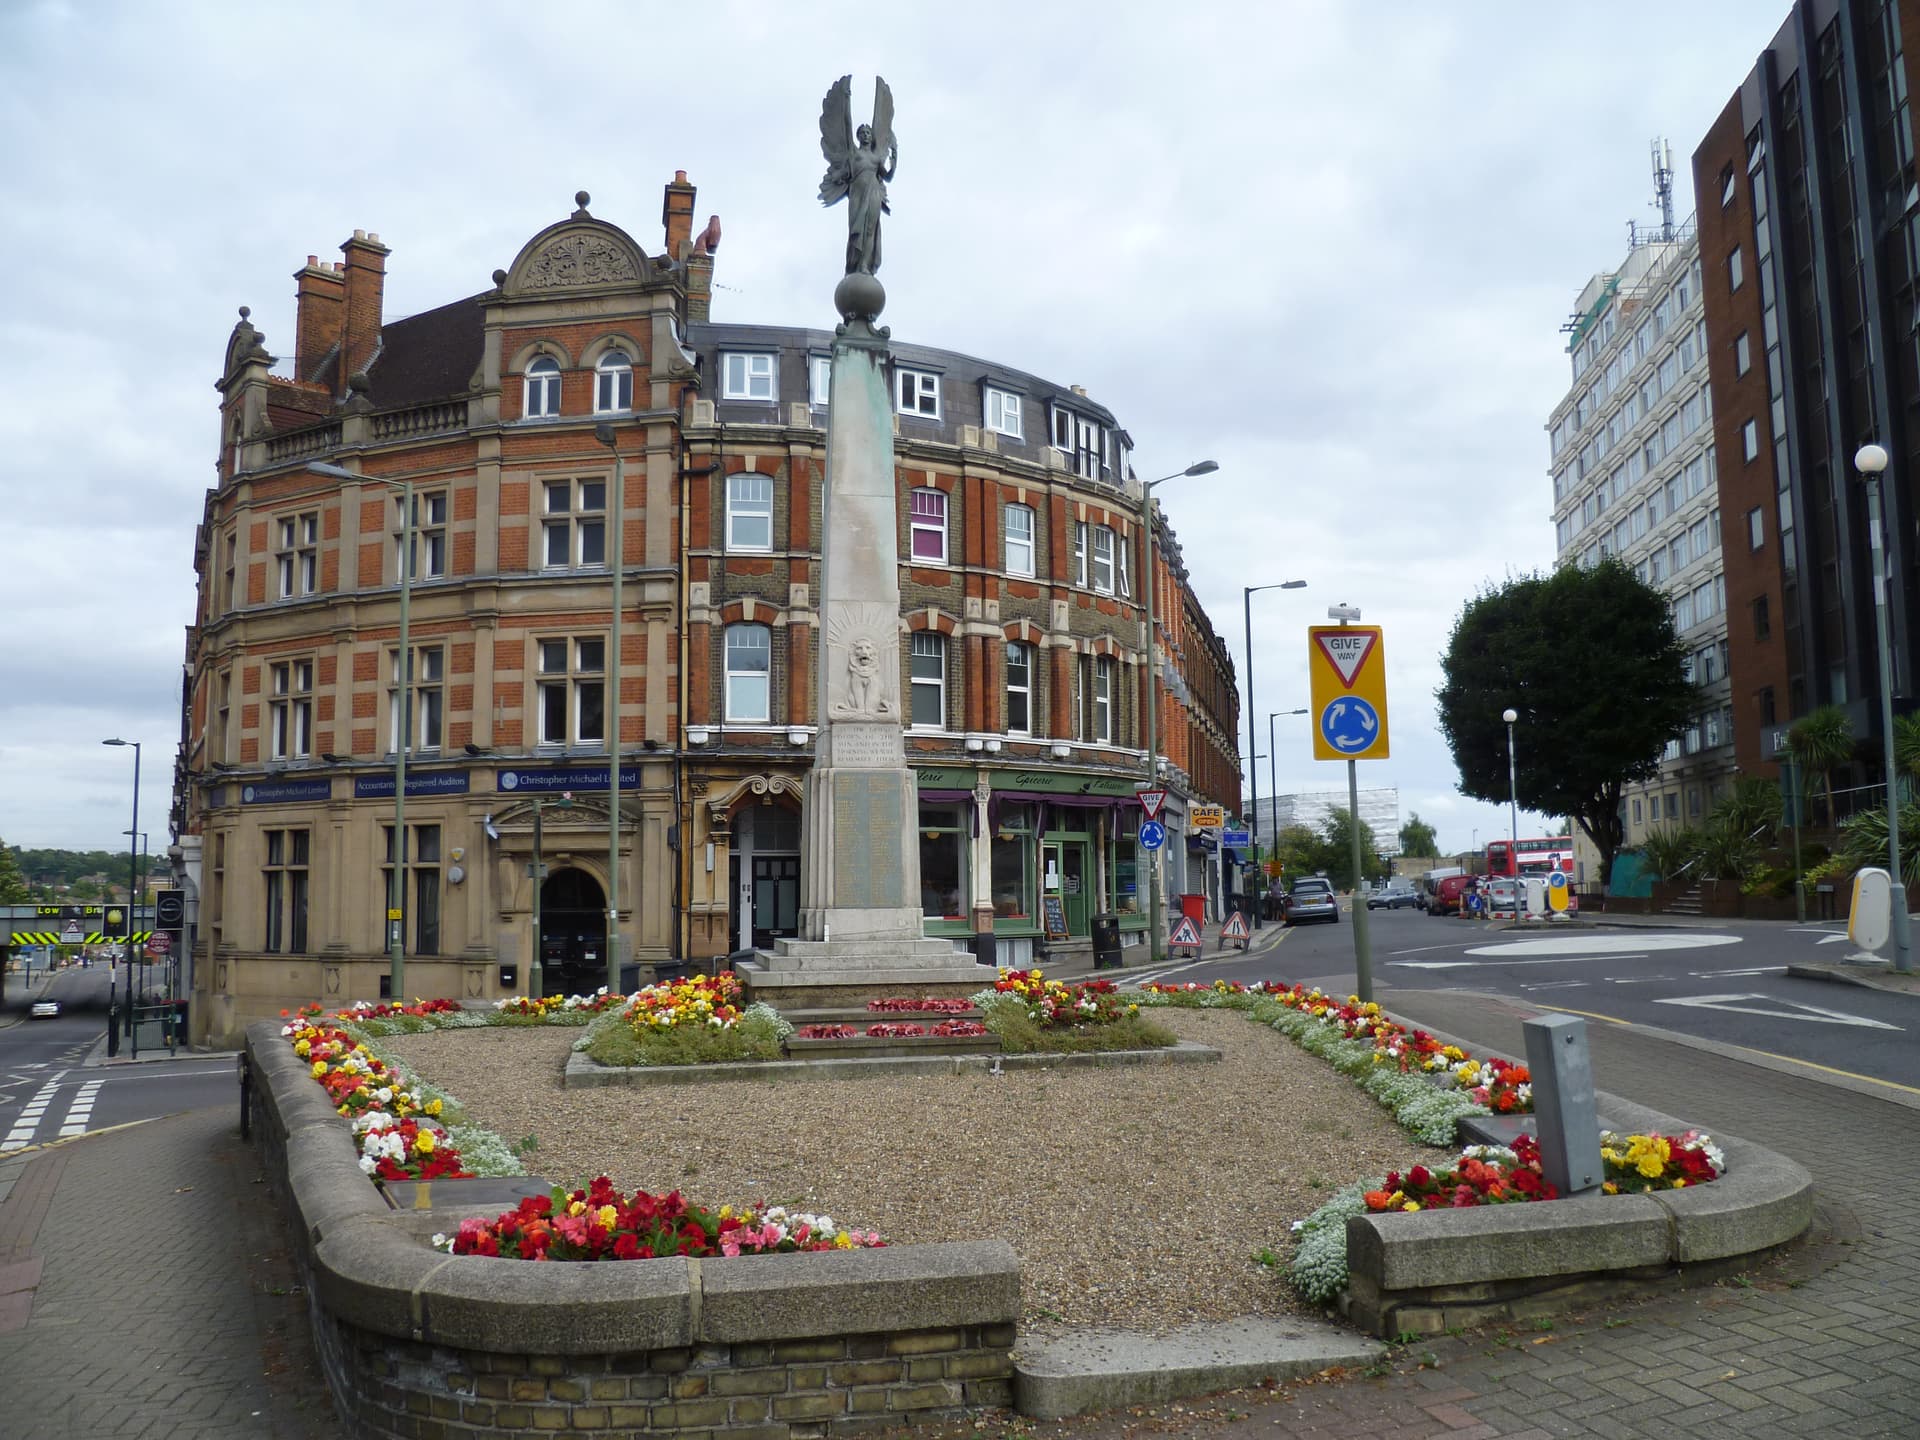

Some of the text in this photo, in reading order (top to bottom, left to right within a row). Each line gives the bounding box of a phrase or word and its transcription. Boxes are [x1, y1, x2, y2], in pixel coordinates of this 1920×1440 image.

[1330, 638, 1361, 649] GIVE
[1337, 652, 1356, 660] WAY
[520, 773, 636, 786] Christopher Michael Liited
[1192, 808, 1220, 817] CAFE
[38, 906, 60, 914] Low
